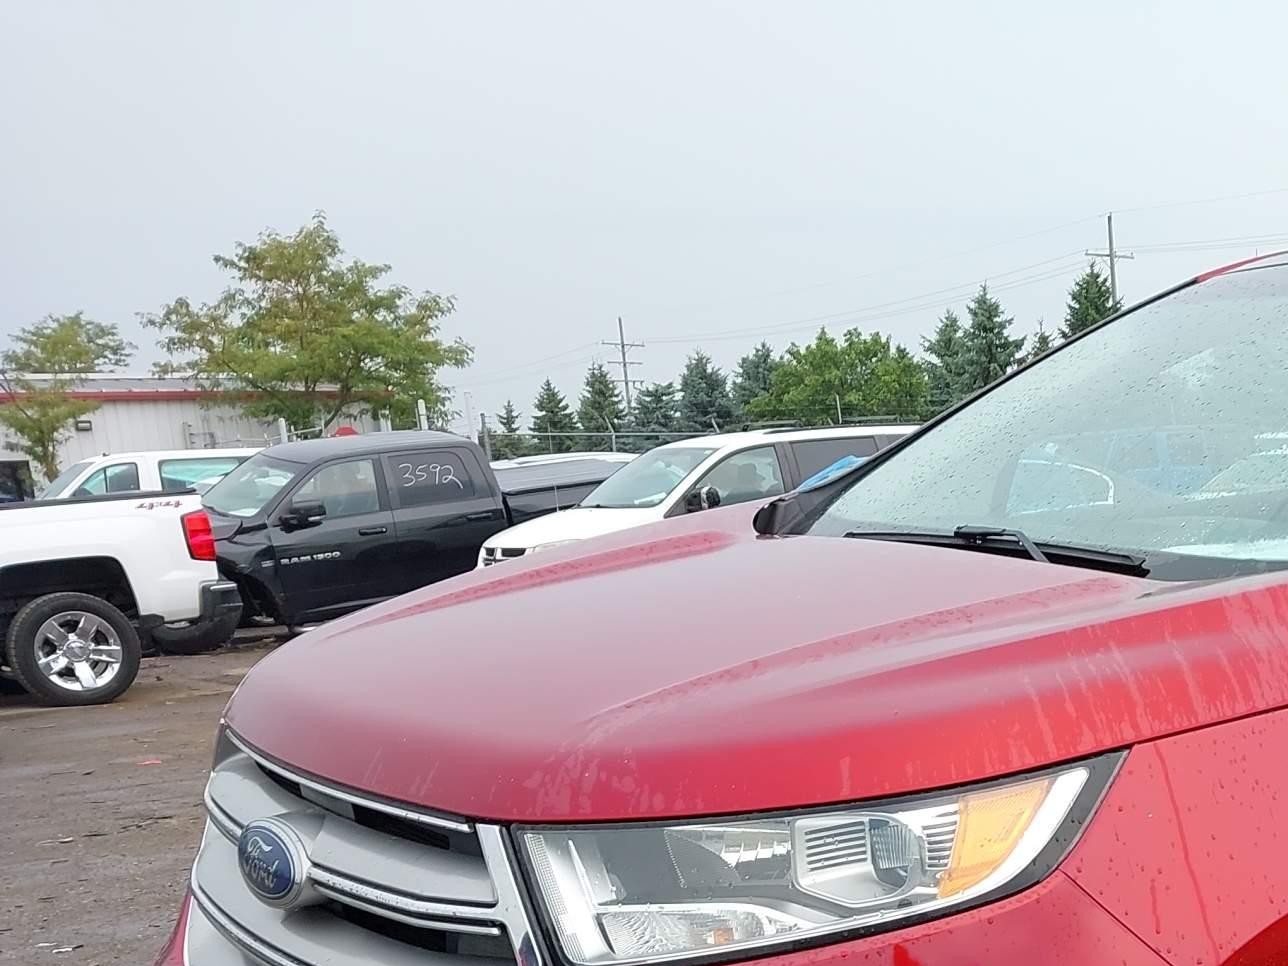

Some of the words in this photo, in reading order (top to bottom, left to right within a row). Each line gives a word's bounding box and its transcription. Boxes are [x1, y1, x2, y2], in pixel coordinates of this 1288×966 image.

[398, 463, 464, 489] 3592
[280, 556, 312, 565] RAM
[313, 551, 341, 561] 1500
[242, 836, 280, 888] Ford
